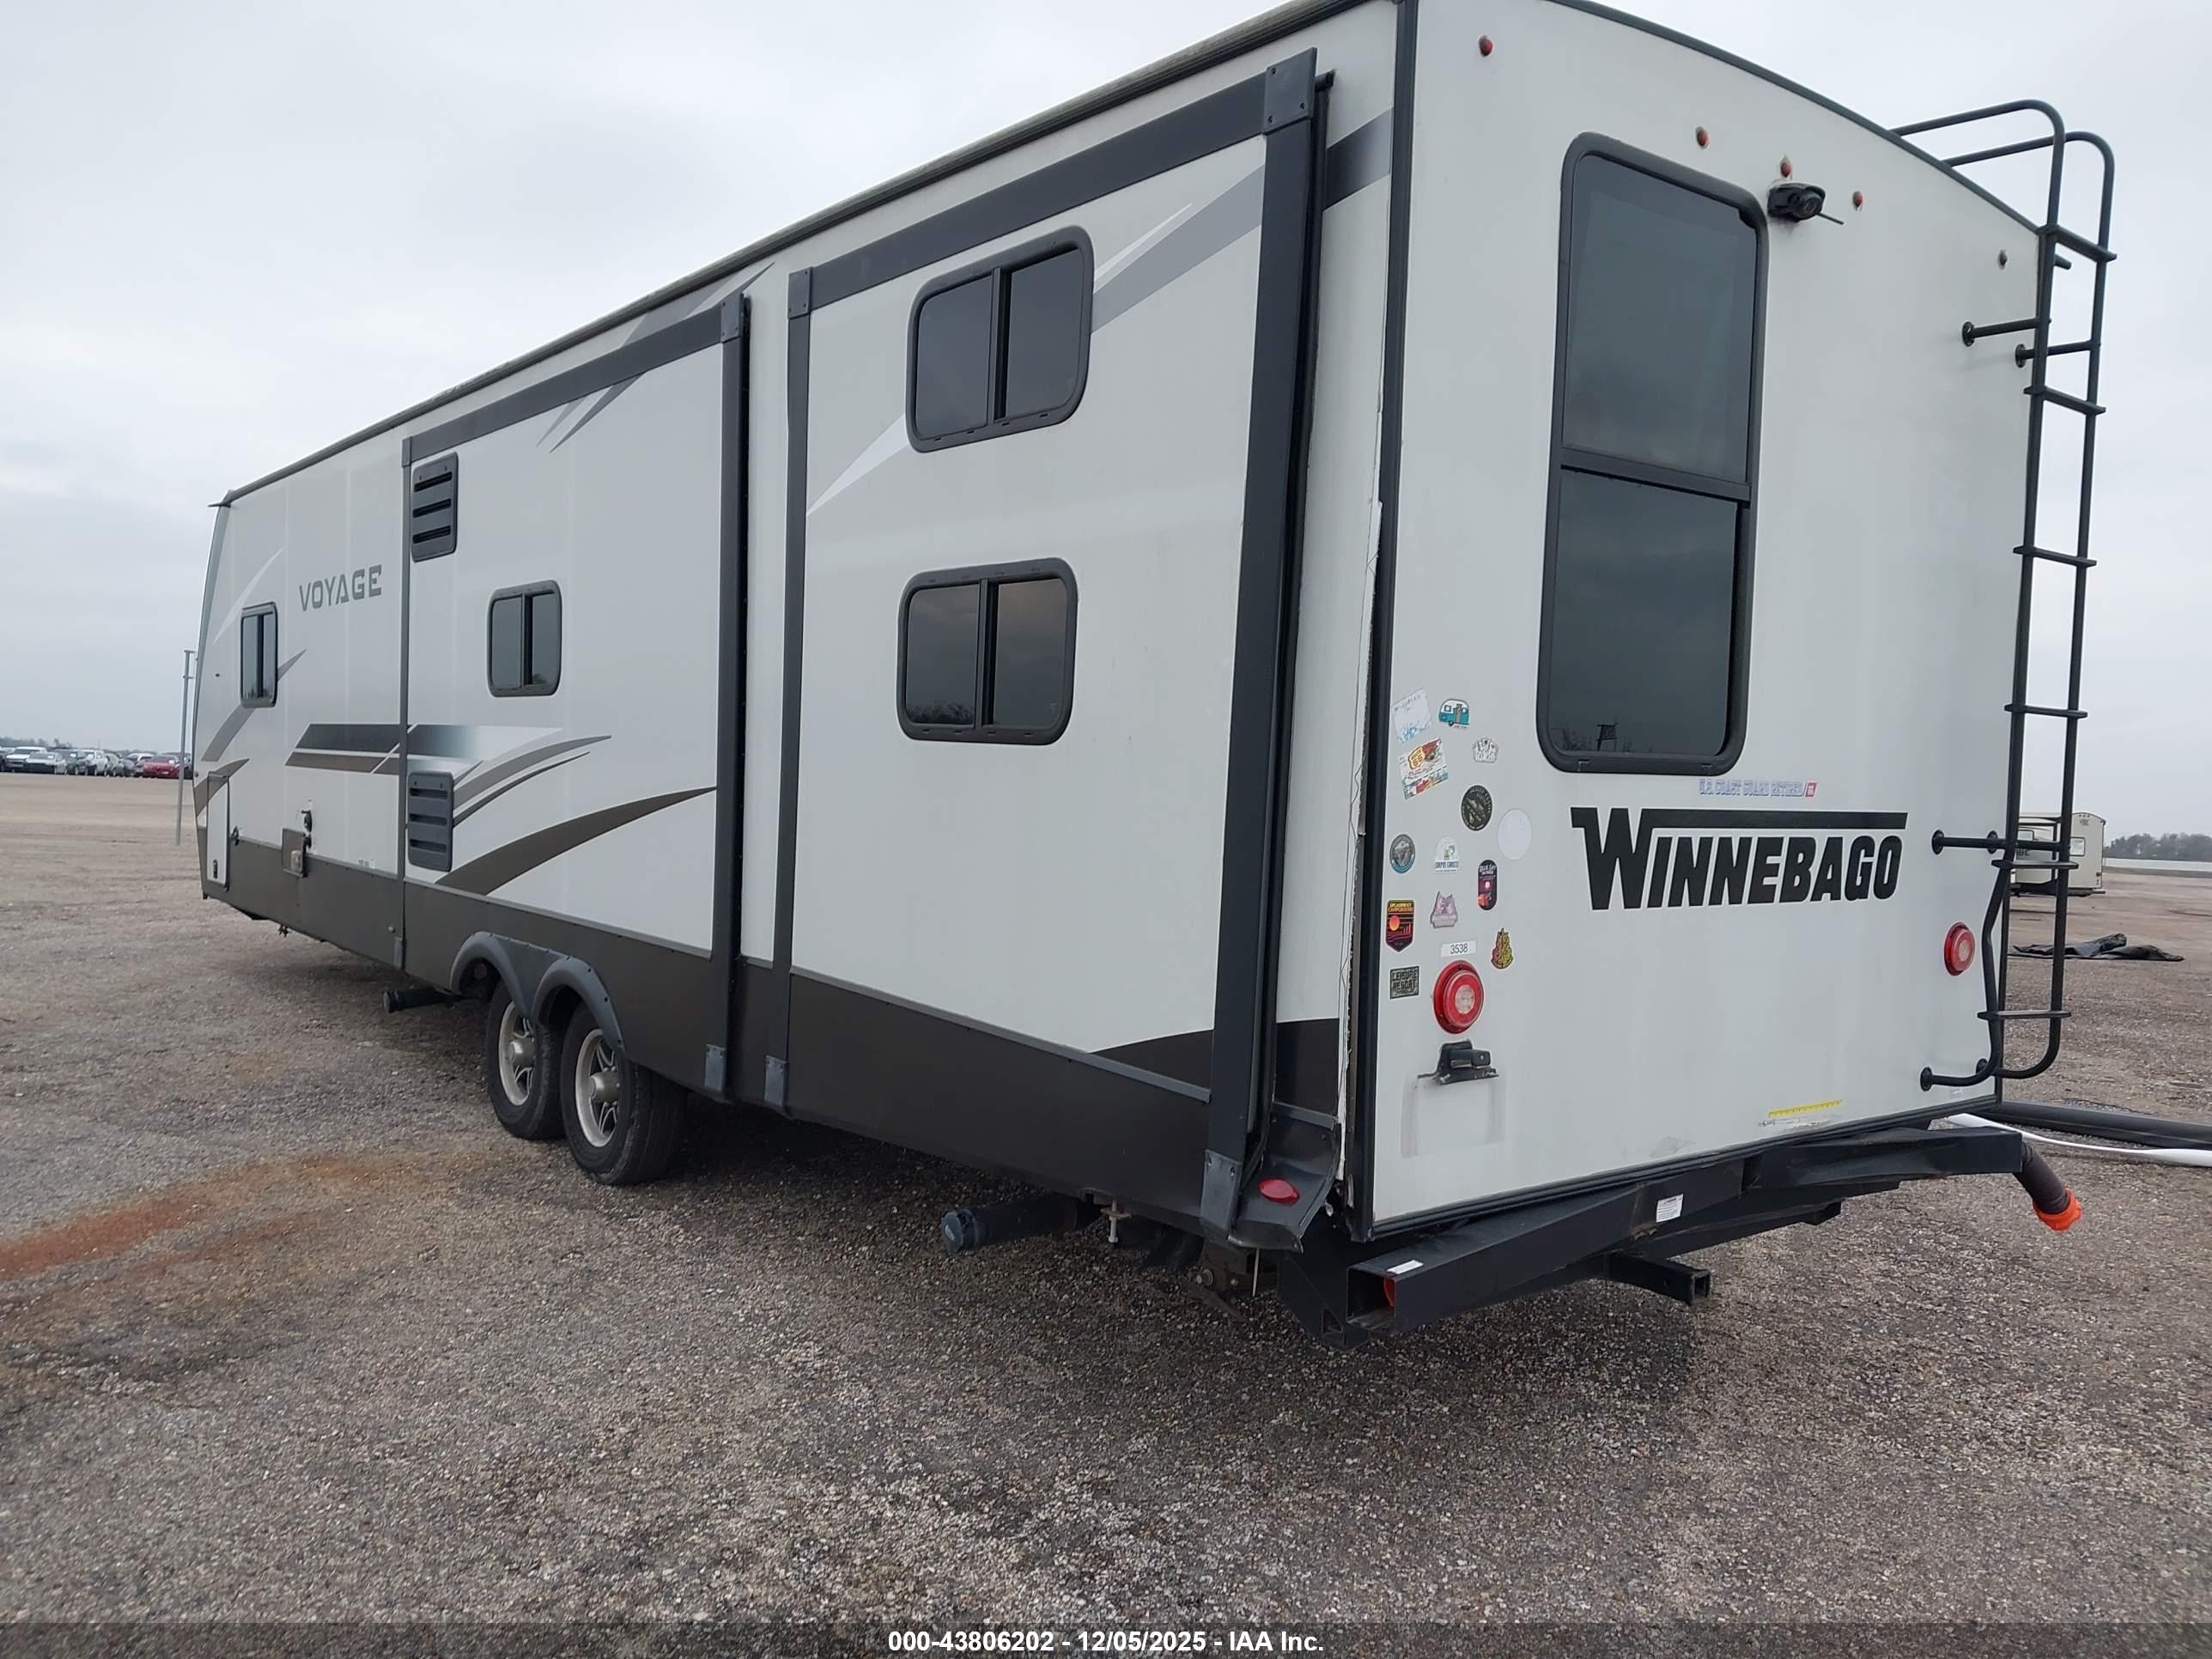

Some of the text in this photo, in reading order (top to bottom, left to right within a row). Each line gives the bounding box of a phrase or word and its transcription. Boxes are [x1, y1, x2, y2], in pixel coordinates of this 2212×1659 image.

[299, 564, 382, 611] VOYAGE
[1571, 807, 1908, 910] WINNEBAGO
[1450, 943, 1468, 954] 3538
